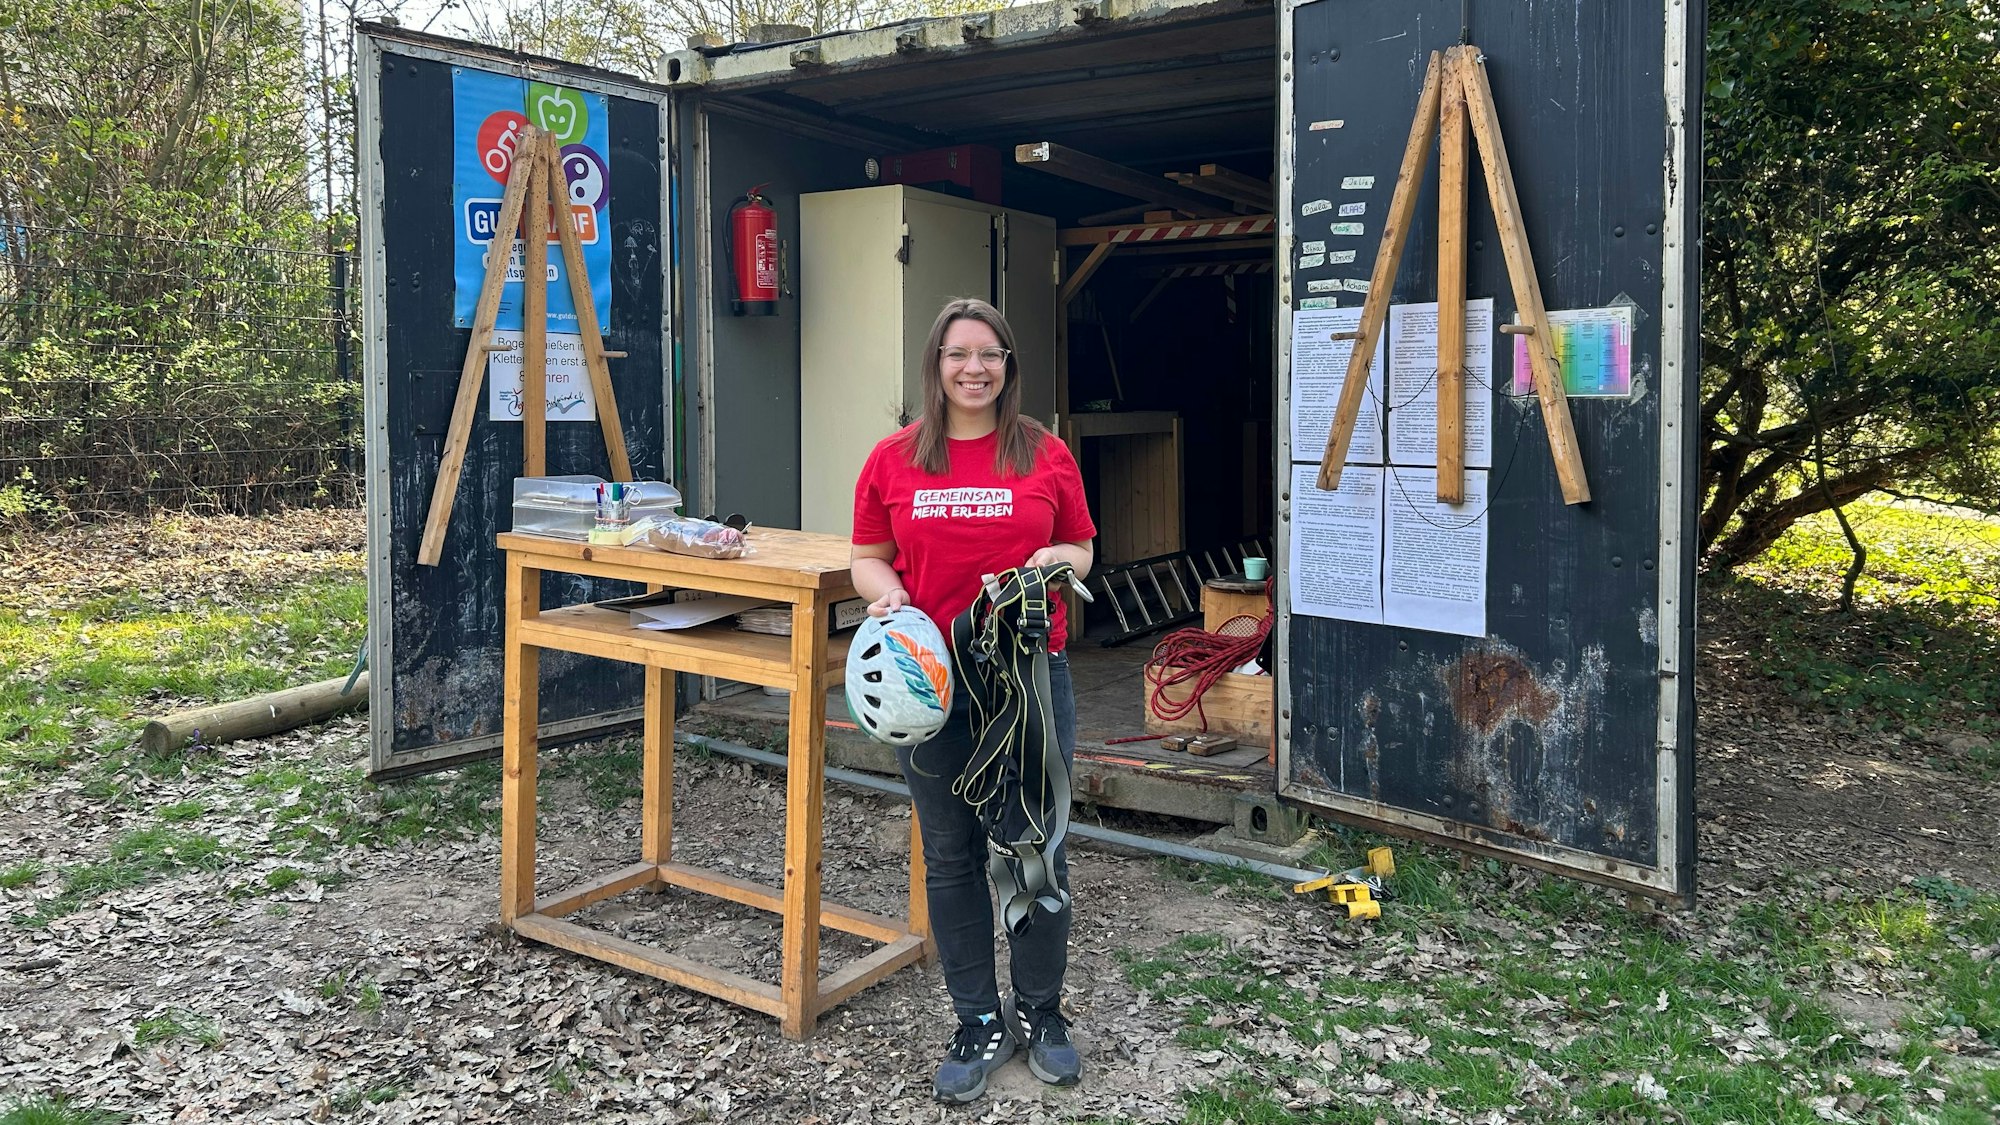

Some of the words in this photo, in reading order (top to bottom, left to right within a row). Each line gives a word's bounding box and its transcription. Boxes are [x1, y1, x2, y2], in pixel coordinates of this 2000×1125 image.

[1340, 204, 1364, 215] KLAAS
[493, 353, 558, 366] Kletteen
[560, 357, 579, 367] erst
[918, 490, 1006, 503] GEMEINSAM
[912, 505, 949, 520] MEHR
[951, 504, 1014, 519] ERLEBEN
